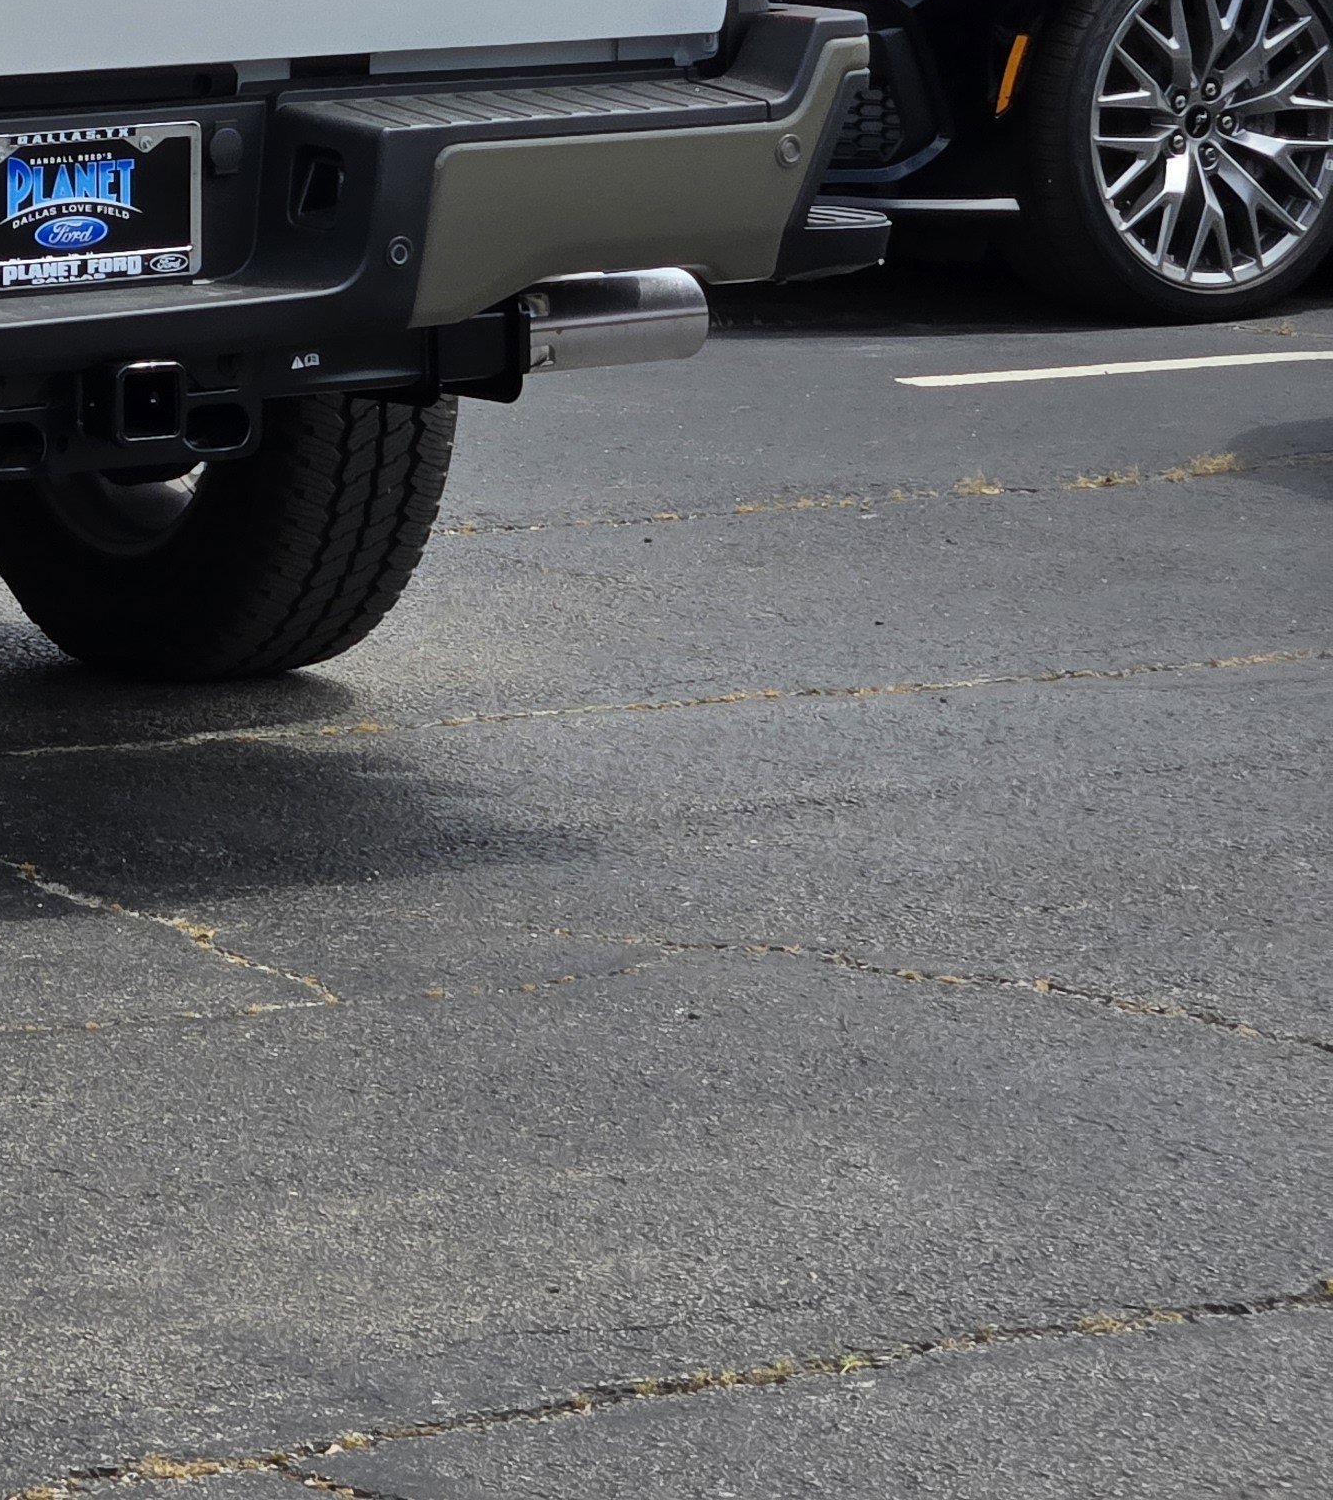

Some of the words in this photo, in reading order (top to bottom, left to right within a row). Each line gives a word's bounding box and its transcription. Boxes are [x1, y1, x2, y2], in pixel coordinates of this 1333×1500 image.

[106, 127, 129, 138] TX
[7, 156, 135, 218] PLANET
[12, 207, 57, 230] DALLAS
[61, 204, 92, 214] LOVE
[96, 205, 130, 220] FIELD
[3, 261, 81, 286] PLANET
[87, 255, 142, 275] FORD
[32, 273, 106, 285] DALLAS
